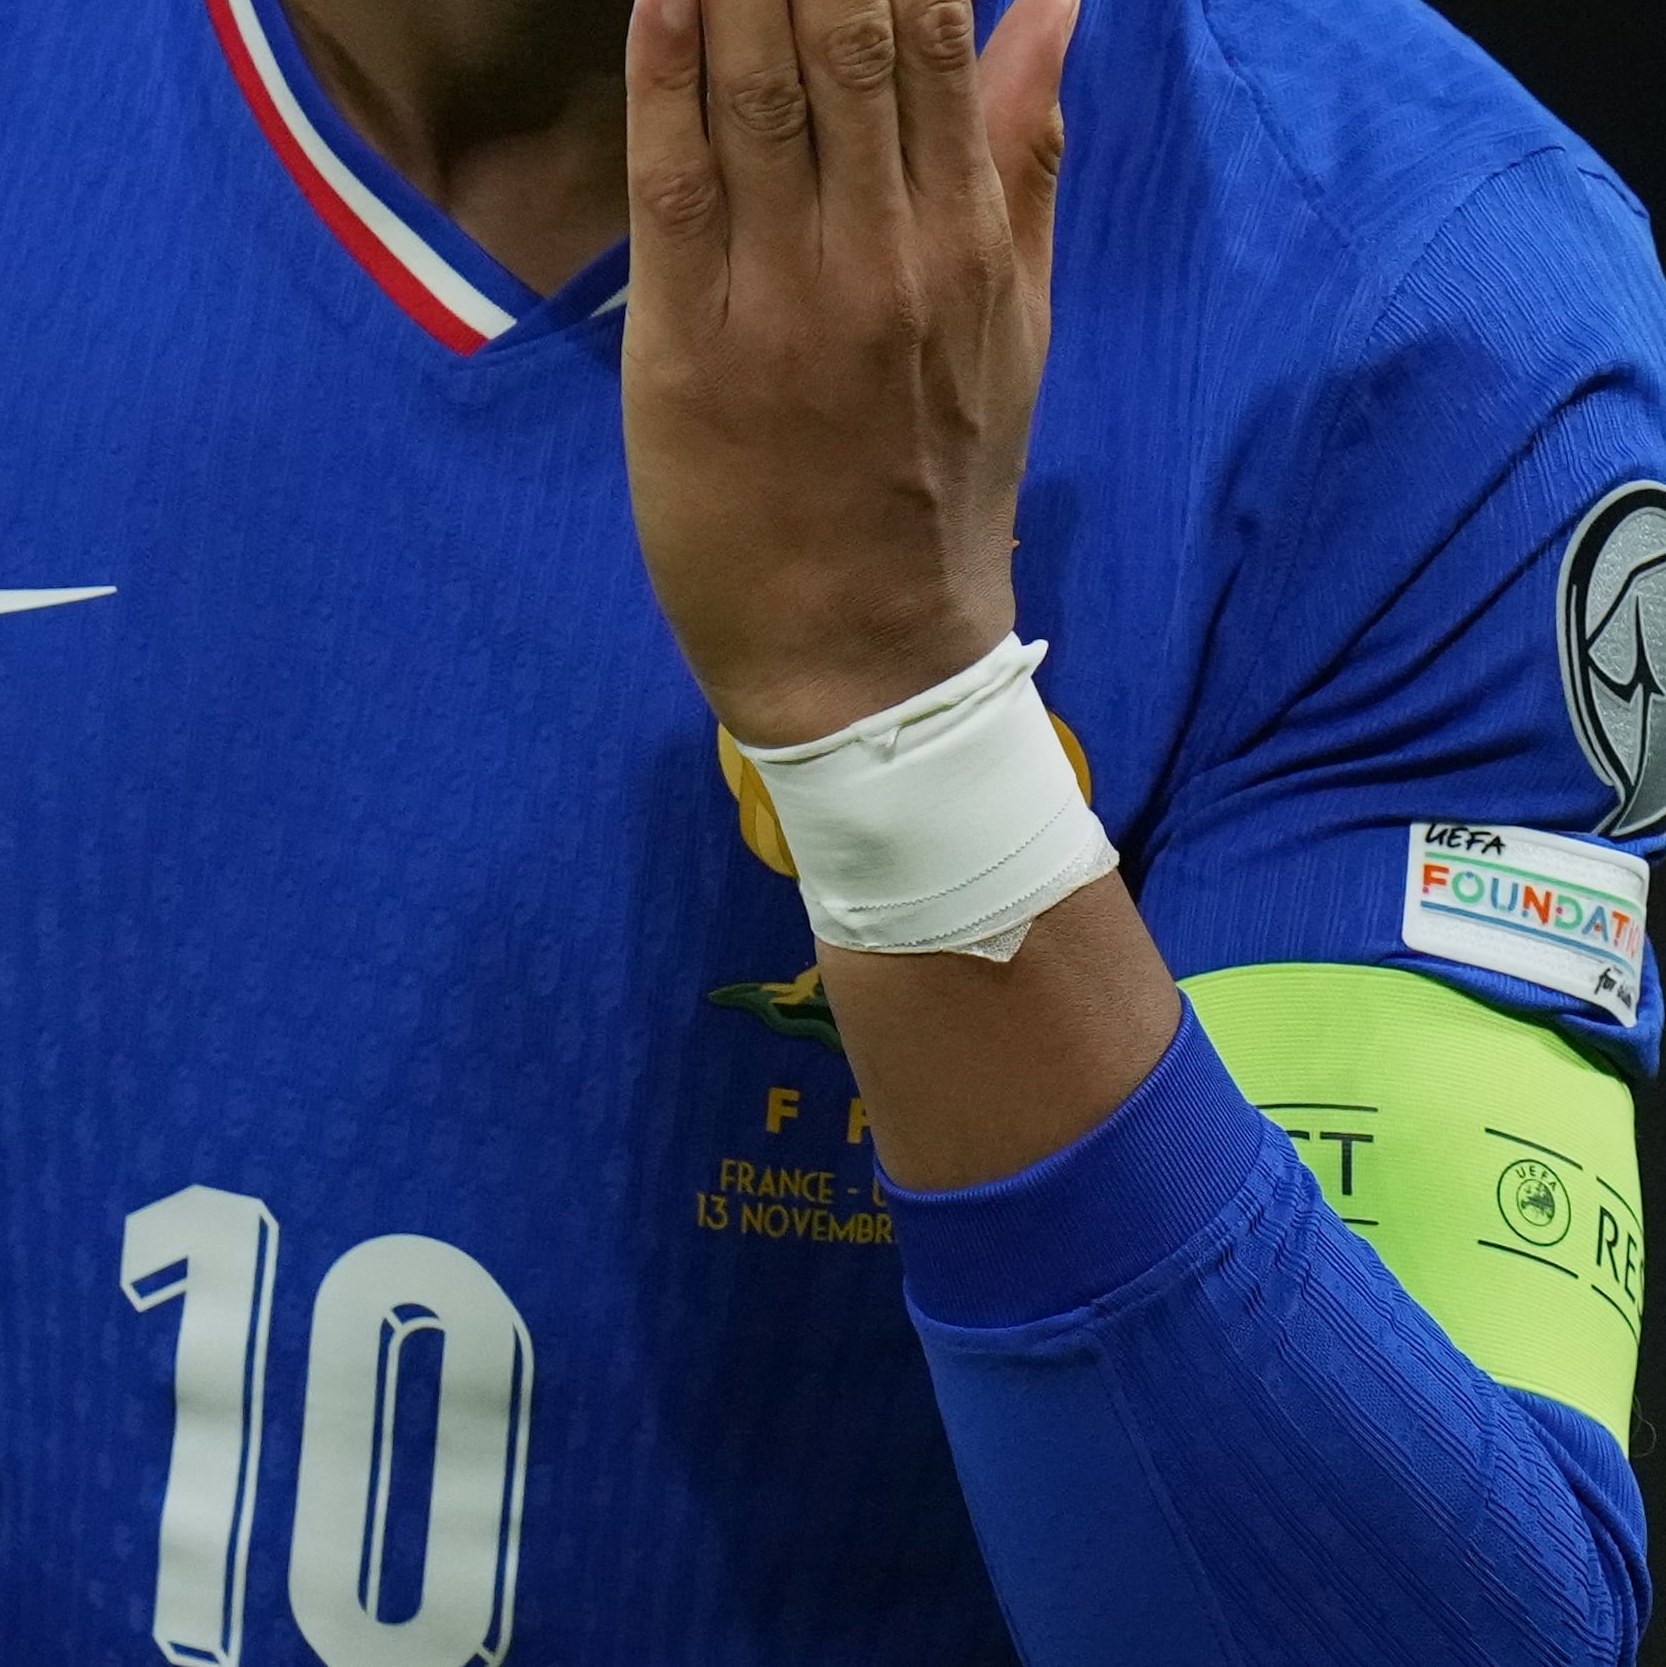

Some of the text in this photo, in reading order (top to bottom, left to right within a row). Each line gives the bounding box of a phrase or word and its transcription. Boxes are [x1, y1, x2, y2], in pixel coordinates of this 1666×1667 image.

[1424, 823, 1506, 855] UEFA
[1422, 863, 1640, 957] FOUNDAT
[720, 1158, 836, 1205] FRANCE
[1284, 1130, 1374, 1196] T
[1515, 1165, 1557, 1192] UEFA
[697, 1192, 729, 1230] 13
[1596, 1205, 1644, 1323] RE
[120, 1184, 535, 1667] 10
